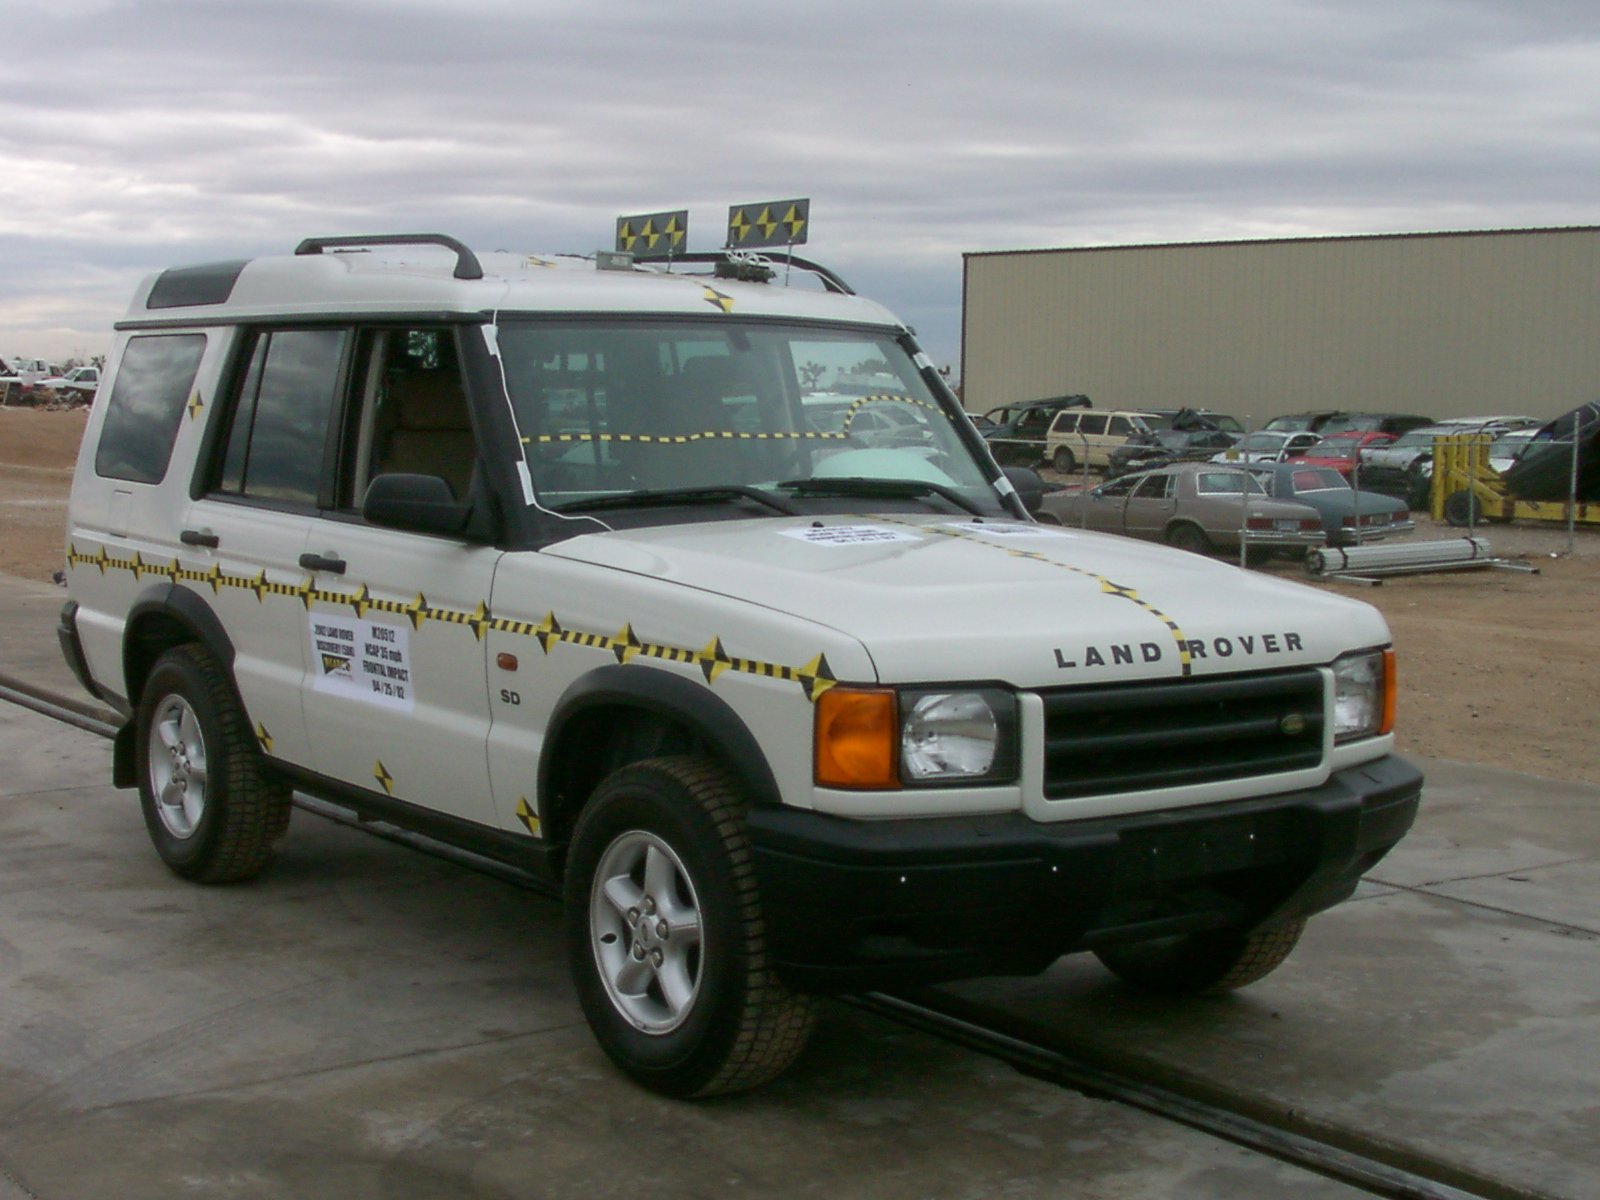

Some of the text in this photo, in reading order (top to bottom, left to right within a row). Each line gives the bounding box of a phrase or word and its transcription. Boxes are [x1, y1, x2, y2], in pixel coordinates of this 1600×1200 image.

[1053, 632, 1304, 669] LAND ROVER
[362, 660, 387, 677] FRONTAL
[386, 665, 409, 682] IMPACT
[500, 688, 521, 706] SD
